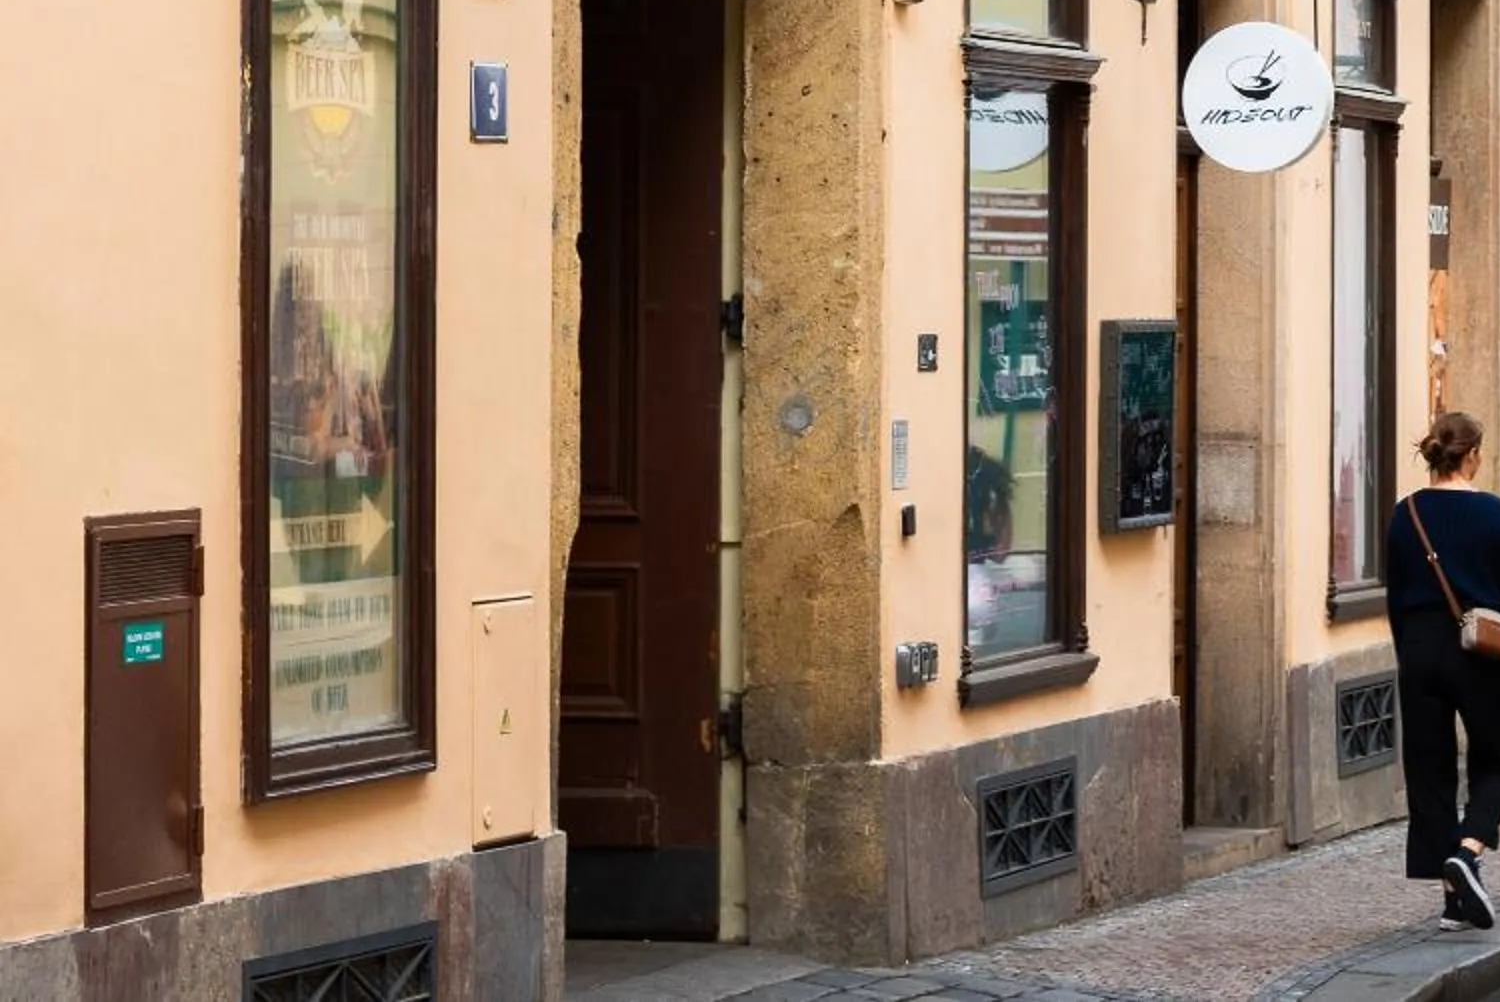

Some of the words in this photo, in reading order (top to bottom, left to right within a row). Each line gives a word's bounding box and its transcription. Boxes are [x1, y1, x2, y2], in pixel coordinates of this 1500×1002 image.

[294, 50, 335, 99] BEER
[488, 81, 499, 120] 3
[1200, 105, 1313, 125] HIDEOUT
